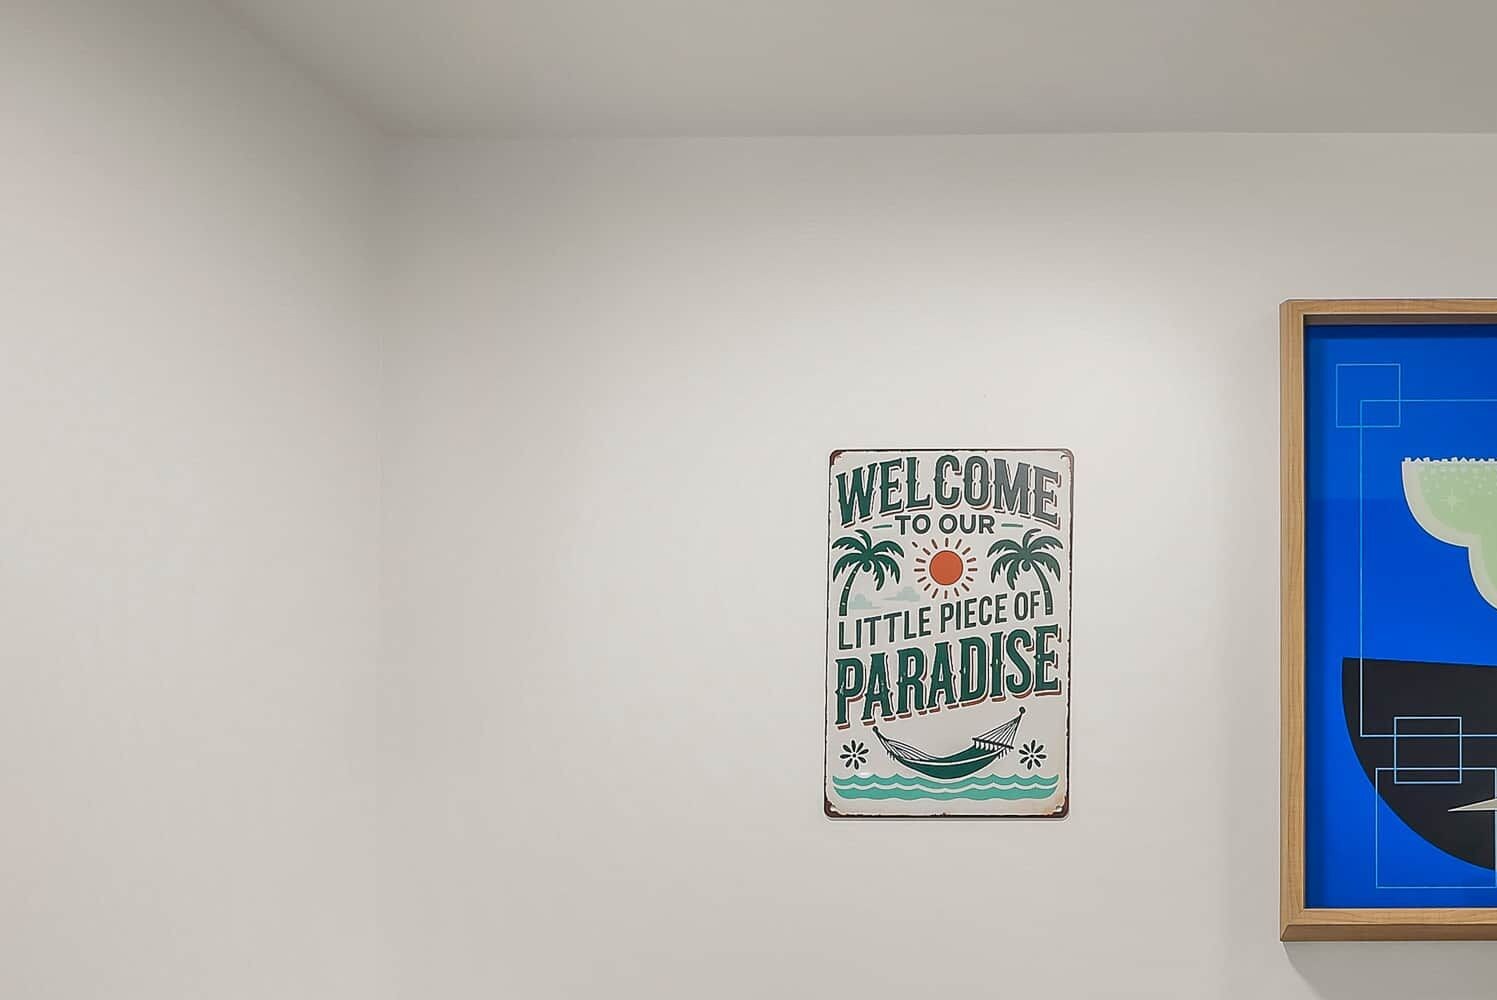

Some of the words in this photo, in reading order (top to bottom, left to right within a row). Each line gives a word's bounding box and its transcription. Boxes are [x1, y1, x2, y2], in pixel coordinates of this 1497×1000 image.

[835, 454, 1061, 530] WELCOME
[895, 515, 931, 535] TO
[938, 514, 995, 534] OUR
[838, 606, 931, 650] LITTLE
[940, 593, 1007, 633] PIECE
[1014, 590, 1041, 619] OF
[835, 624, 1062, 730] PARADISE
